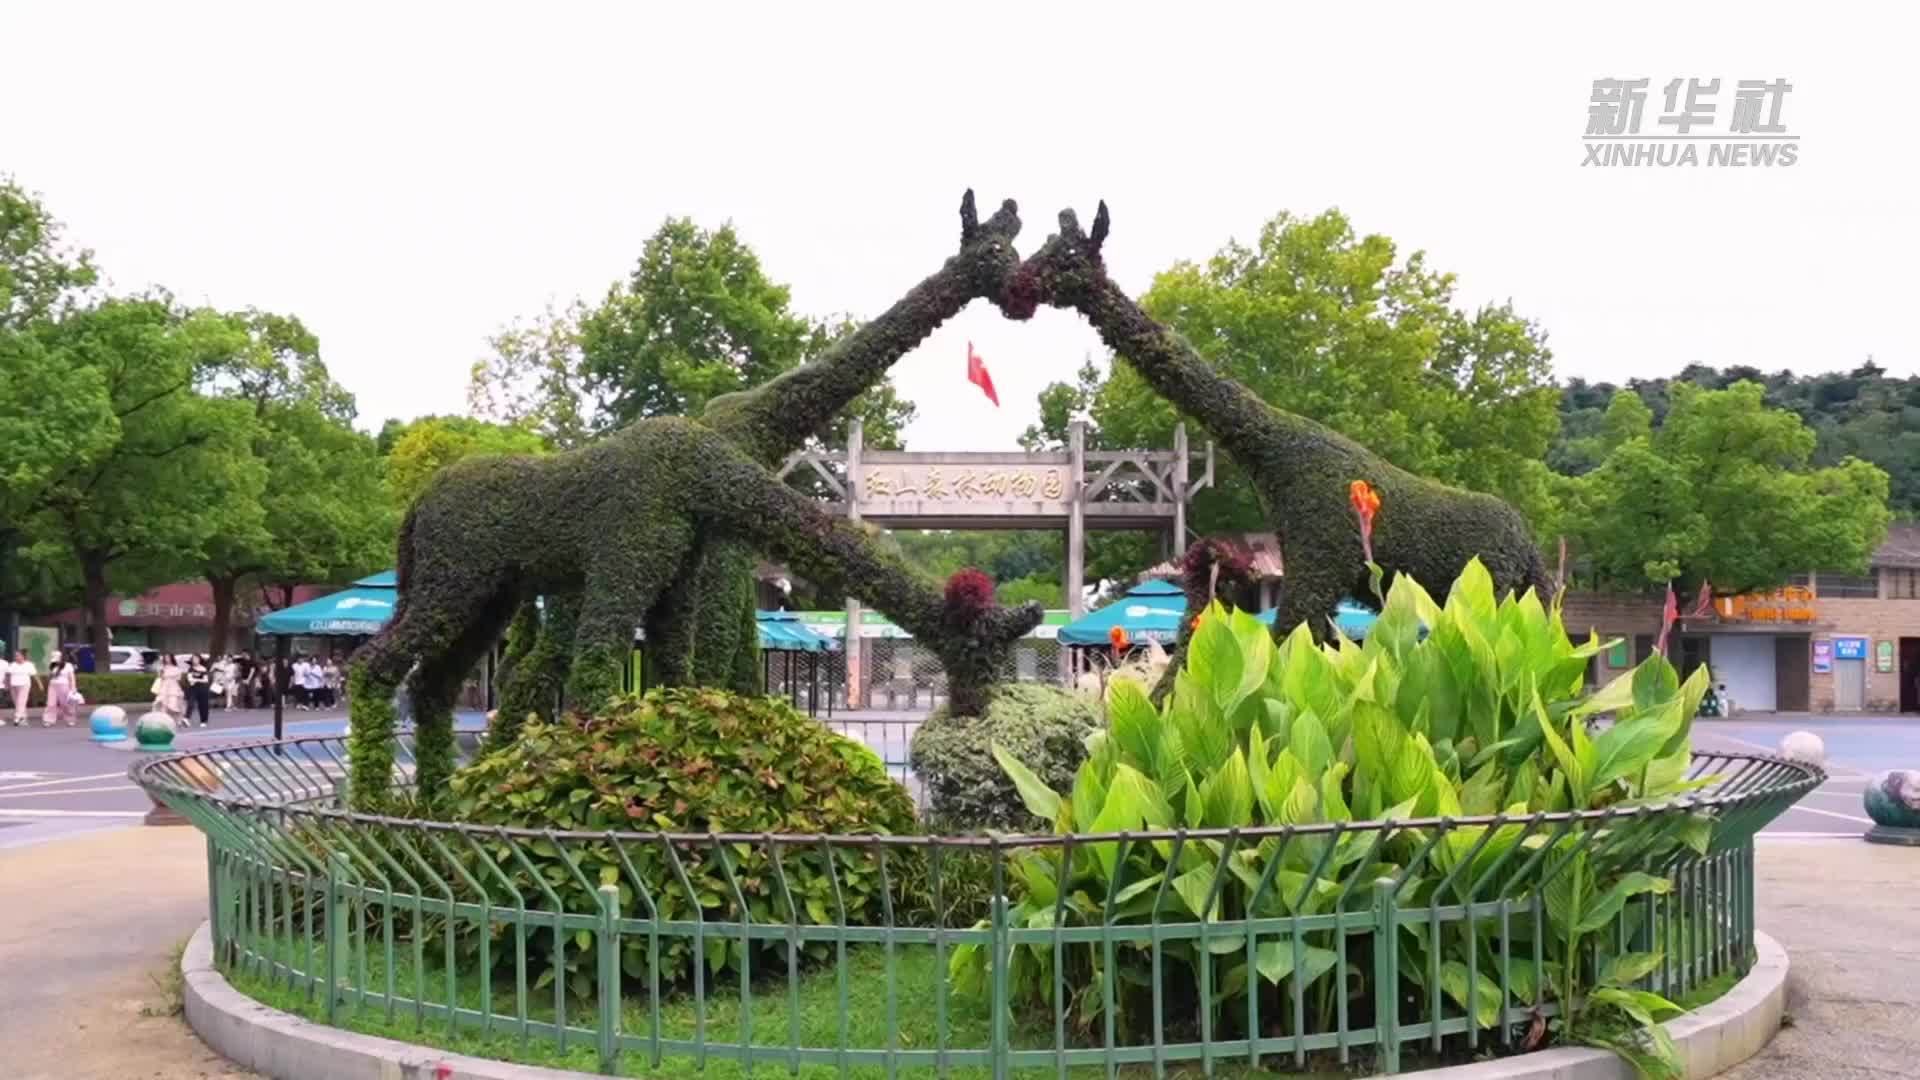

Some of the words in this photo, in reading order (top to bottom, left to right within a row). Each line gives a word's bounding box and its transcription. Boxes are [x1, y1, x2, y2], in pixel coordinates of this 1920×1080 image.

[865, 466, 1064, 499] 红山森林动物园
